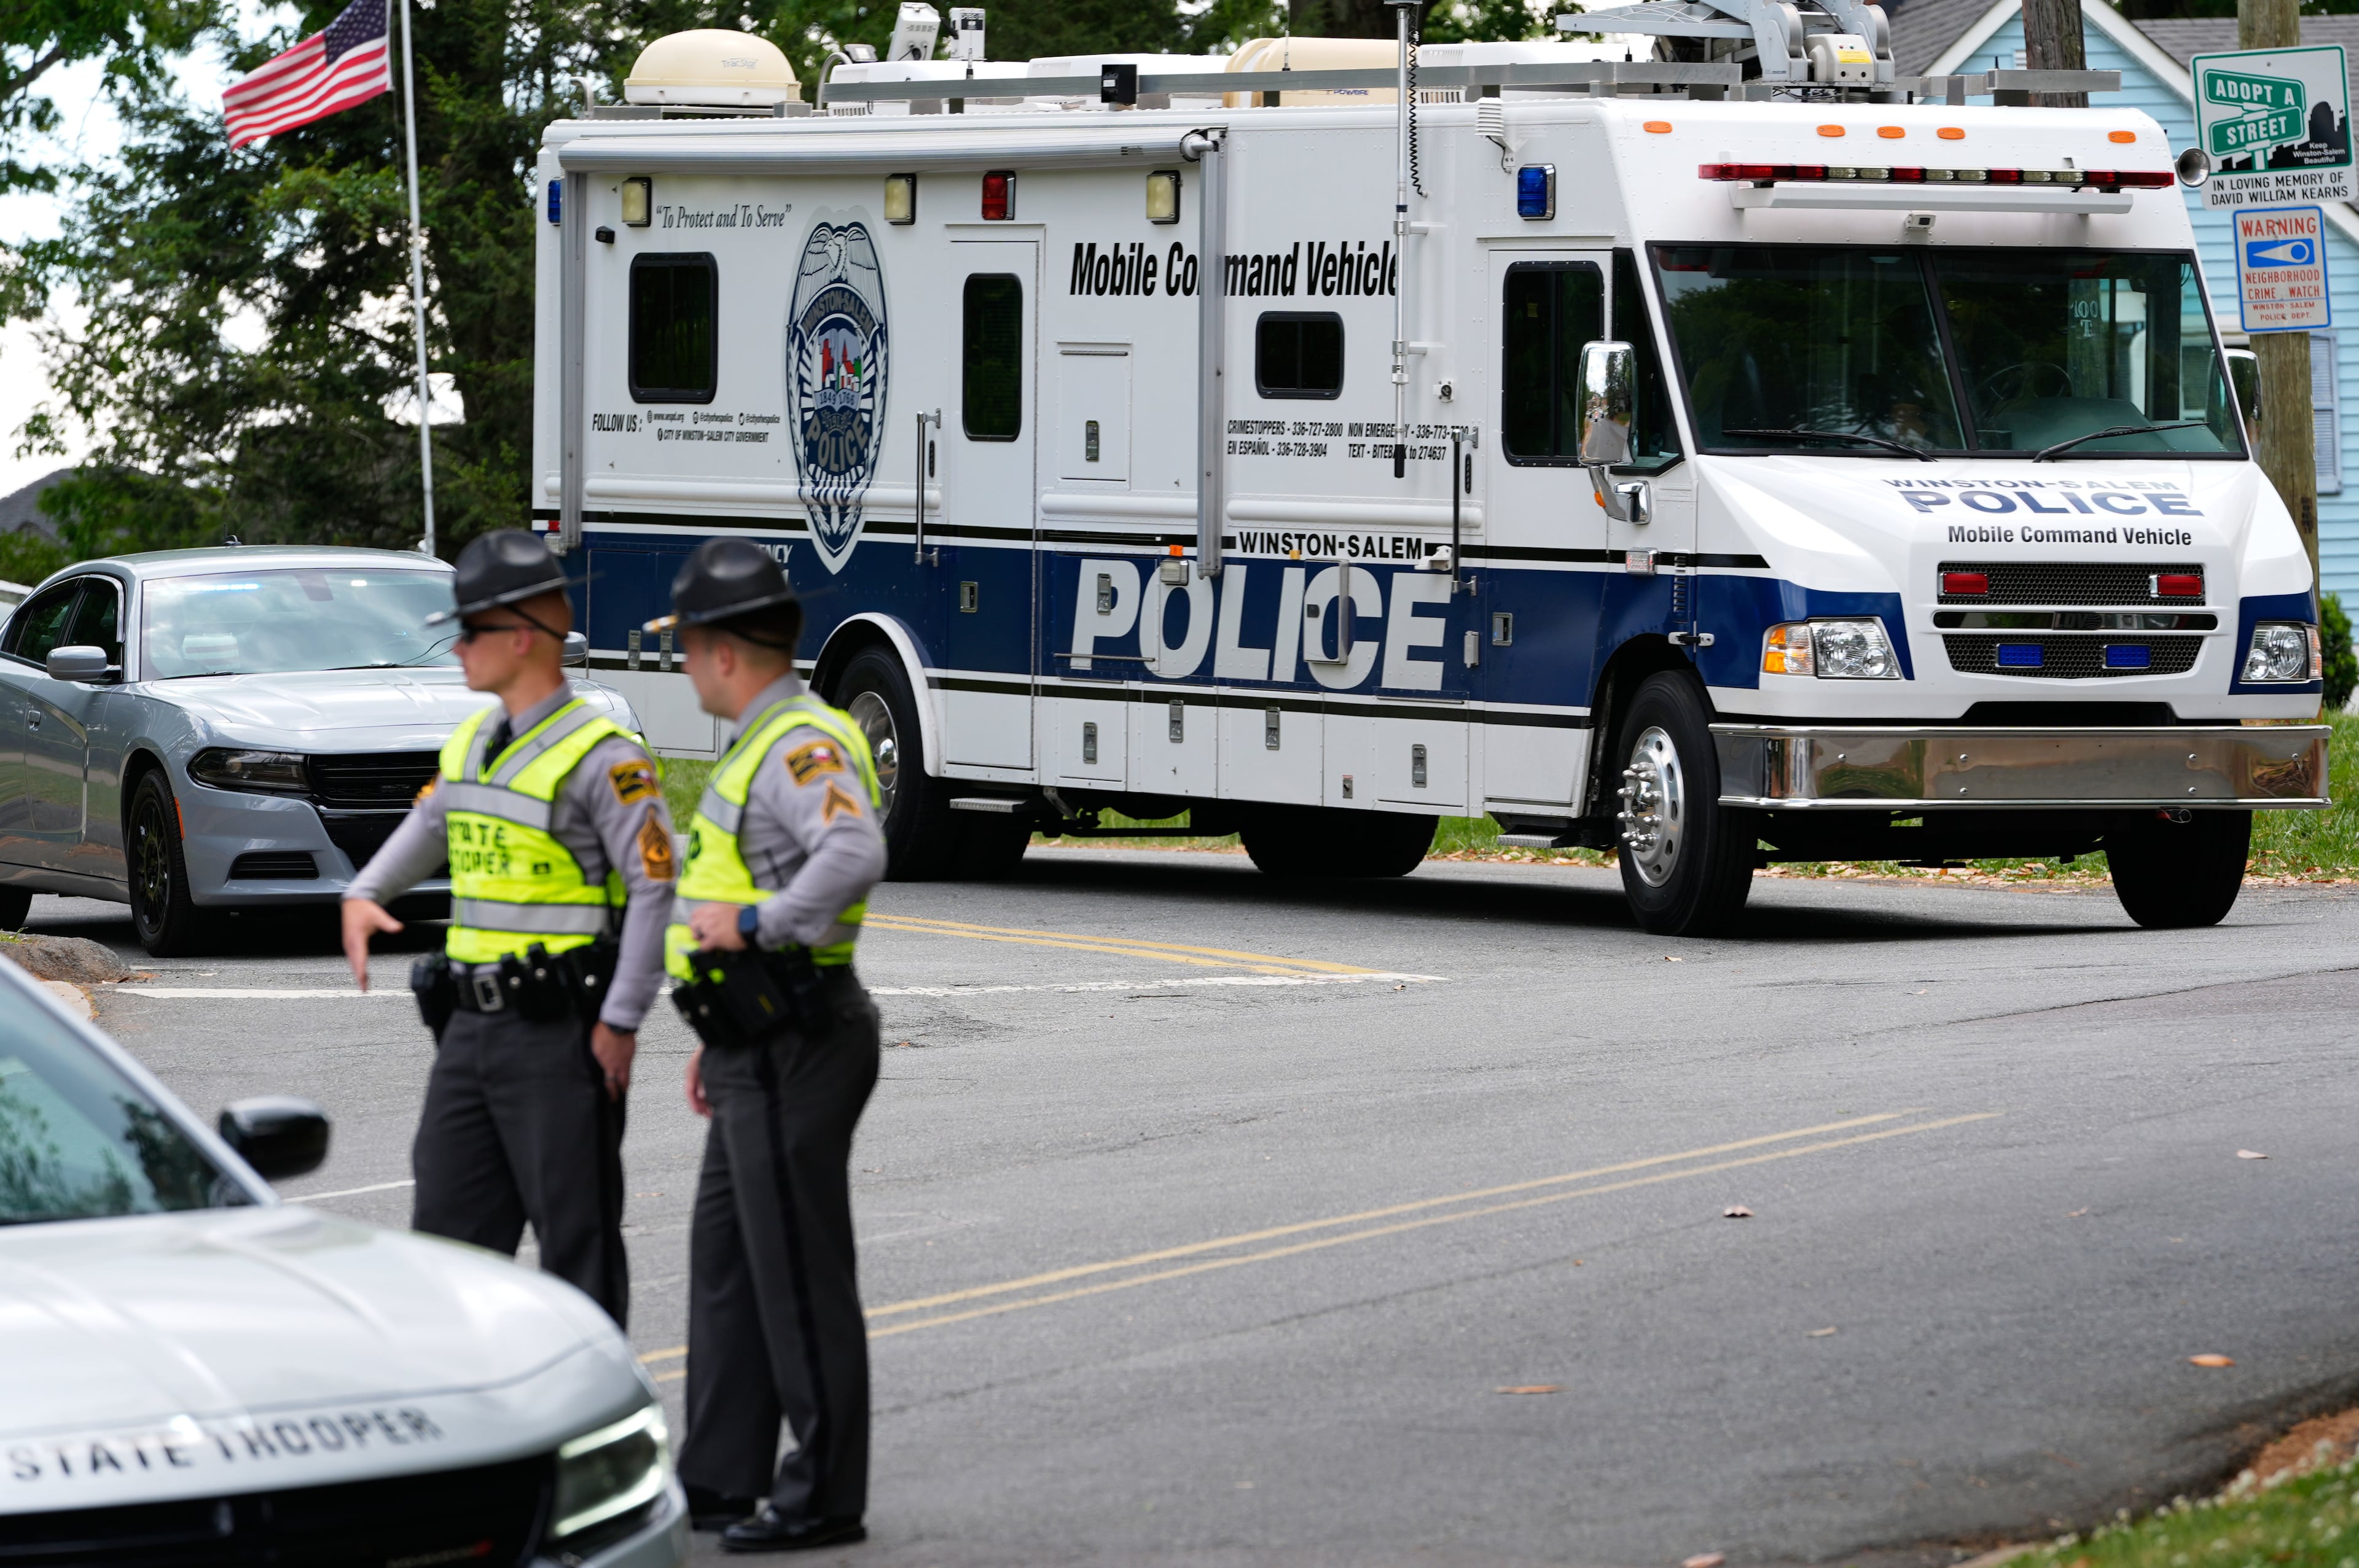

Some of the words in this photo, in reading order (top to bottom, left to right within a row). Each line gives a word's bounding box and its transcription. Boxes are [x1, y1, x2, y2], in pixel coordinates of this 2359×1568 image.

[2216, 79, 2273, 103] ADOPT
[2284, 87, 2295, 106] A
[2226, 116, 2287, 146] STREET
[2293, 149, 2345, 158] Winston-Salem
[2304, 156, 2335, 165] Beautiful
[2213, 180, 2224, 191] IN
[2230, 177, 2269, 190] LOVING
[2275, 173, 2324, 187] MEMORY
[2330, 172, 2344, 183] OF
[2212, 193, 2243, 205] DAVID
[2249, 190, 2296, 203] WILLIAM
[2302, 186, 2348, 200] KEARNS
[676, 206, 713, 228] Protect
[716, 204, 738, 227] and
[740, 205, 752, 227] To
[2241, 217, 2317, 238] WARNING
[1070, 242, 1157, 296] Mobile
[1166, 241, 1301, 296] Comand
[2245, 269, 2320, 284] NEIGHBORHOOD
[2248, 287, 2276, 300] CRIME
[2289, 286, 2320, 298] WATCH
[801, 290, 875, 338] WINSTON-SALEM
[820, 391, 836, 405] 1849
[592, 414, 625, 431] FOLLOW
[626, 414, 638, 432] US
[1227, 420, 1286, 435] CRIMESTOPPERS
[1292, 422, 1343, 437] 336-727-2800
[1348, 423, 1364, 437] NON
[1365, 423, 1410, 438] EMERGEY
[663, 430, 674, 441] CITY
[675, 430, 681, 441] OF
[682, 430, 722, 442] WINSTON-SALEM
[724, 431, 735, 442] CITY
[736, 431, 769, 442] GOVERNMENT
[806, 413, 868, 472] POLICE
[1227, 440, 1237, 455] EN
[1238, 437, 1269, 456] ESPAÑOL
[1277, 442, 1327, 457] 336-728-3904
[1348, 444, 1366, 458] TEXT
[1409, 445, 1416, 459] to
[1418, 445, 1447, 460] 274637
[1880, 478, 2180, 491] WINSTON-SALEM
[1898, 491, 2205, 517] POLICE
[1947, 525, 2014, 544] Mobile
[2021, 525, 2118, 544] Command
[2122, 527, 2192, 546] Vehicle
[1238, 531, 1422, 560] WINSTON-SALEM
[1070, 558, 1453, 690] POLICE
